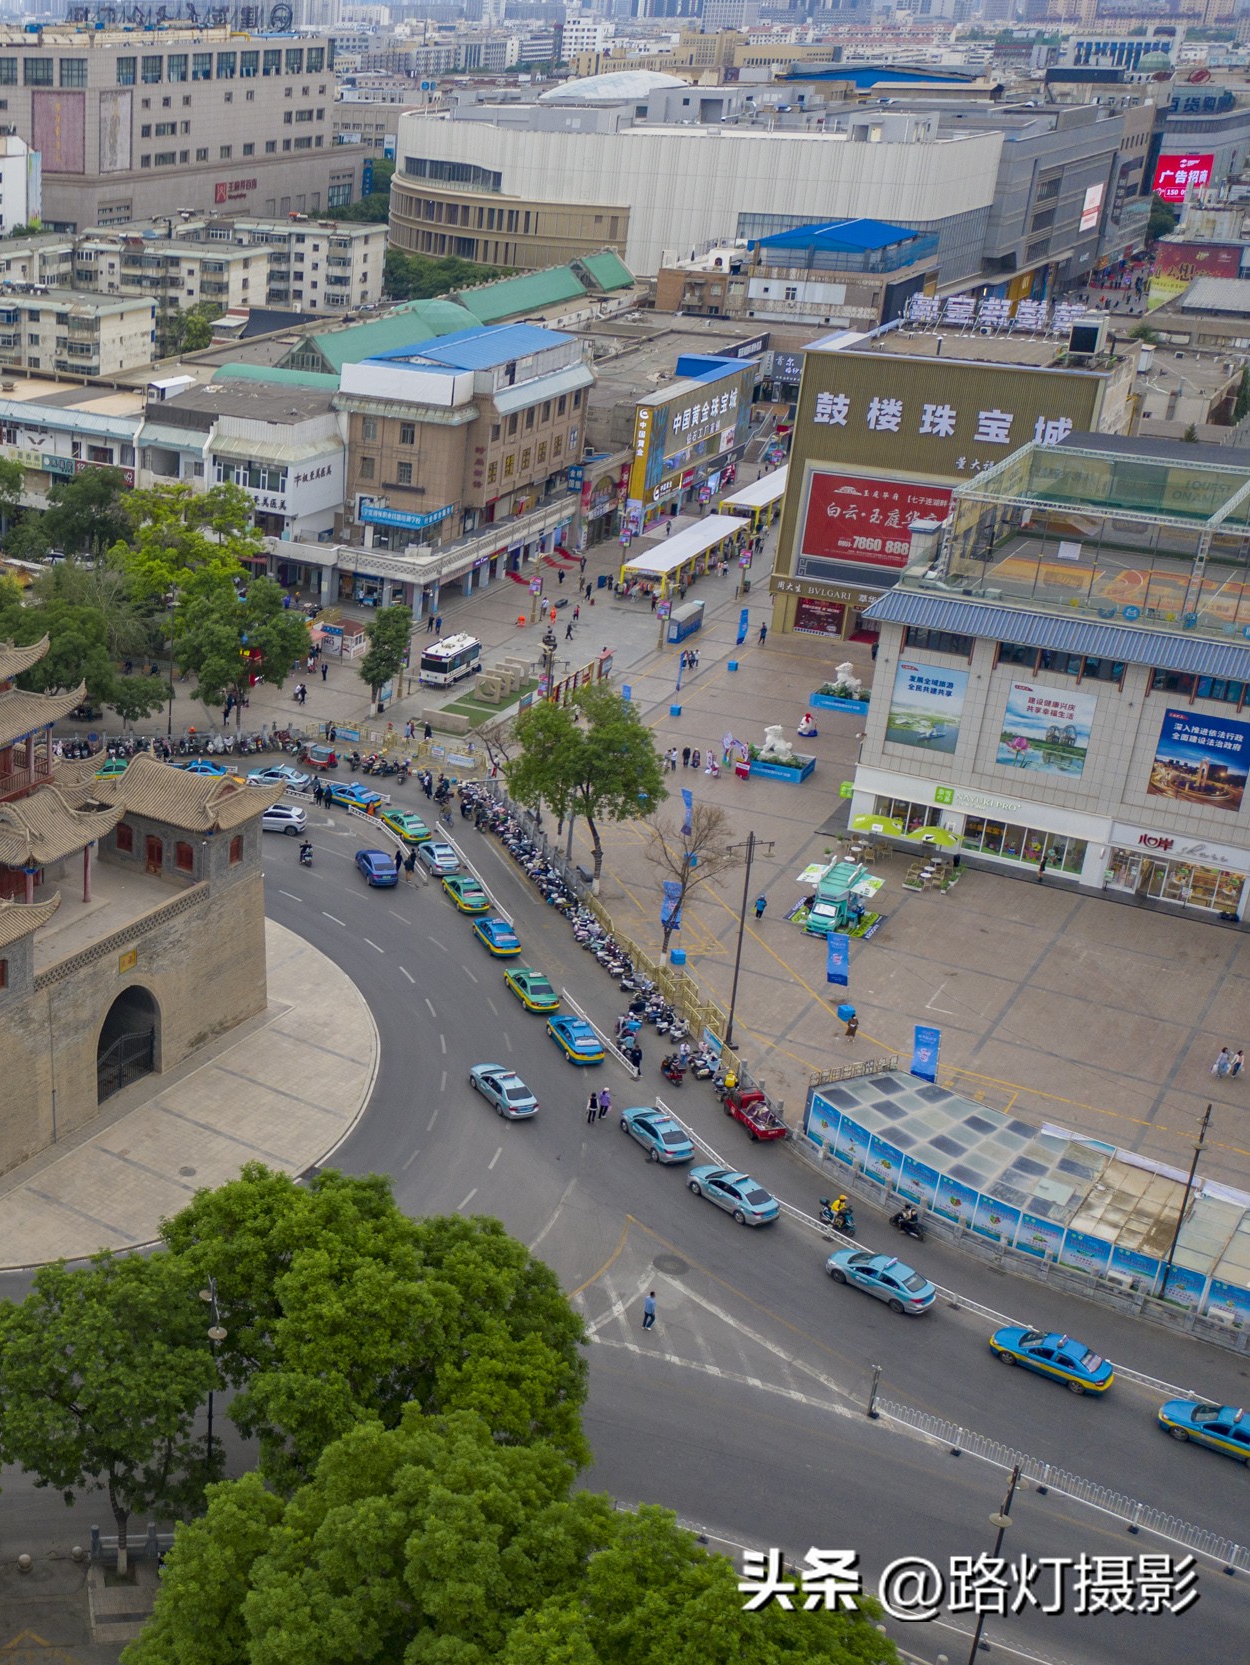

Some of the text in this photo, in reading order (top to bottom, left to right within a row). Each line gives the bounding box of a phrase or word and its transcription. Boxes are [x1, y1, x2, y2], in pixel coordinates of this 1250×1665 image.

[1159, 170, 1208, 184] 广告招商
[672, 387, 738, 435] 中国黄金珠宝城
[813, 391, 1073, 445] 鼓楼珠宝城
[777, 581, 801, 592] 周大生
[808, 587, 851, 600] BVLGARI
[909, 674, 954, 689] 发展全域旅游
[907, 683, 953, 698] 全民共建共享
[1028, 696, 1076, 712] 建设健康兴庆
[1026, 705, 1074, 721] 共享幸福生活
[1173, 722, 1244, 742] 深入推进依法行政
[1171, 732, 1242, 752] 全面建设法治政府
[956, 793, 994, 807] NAYUKI
[996, 802, 1016, 811] PRO
